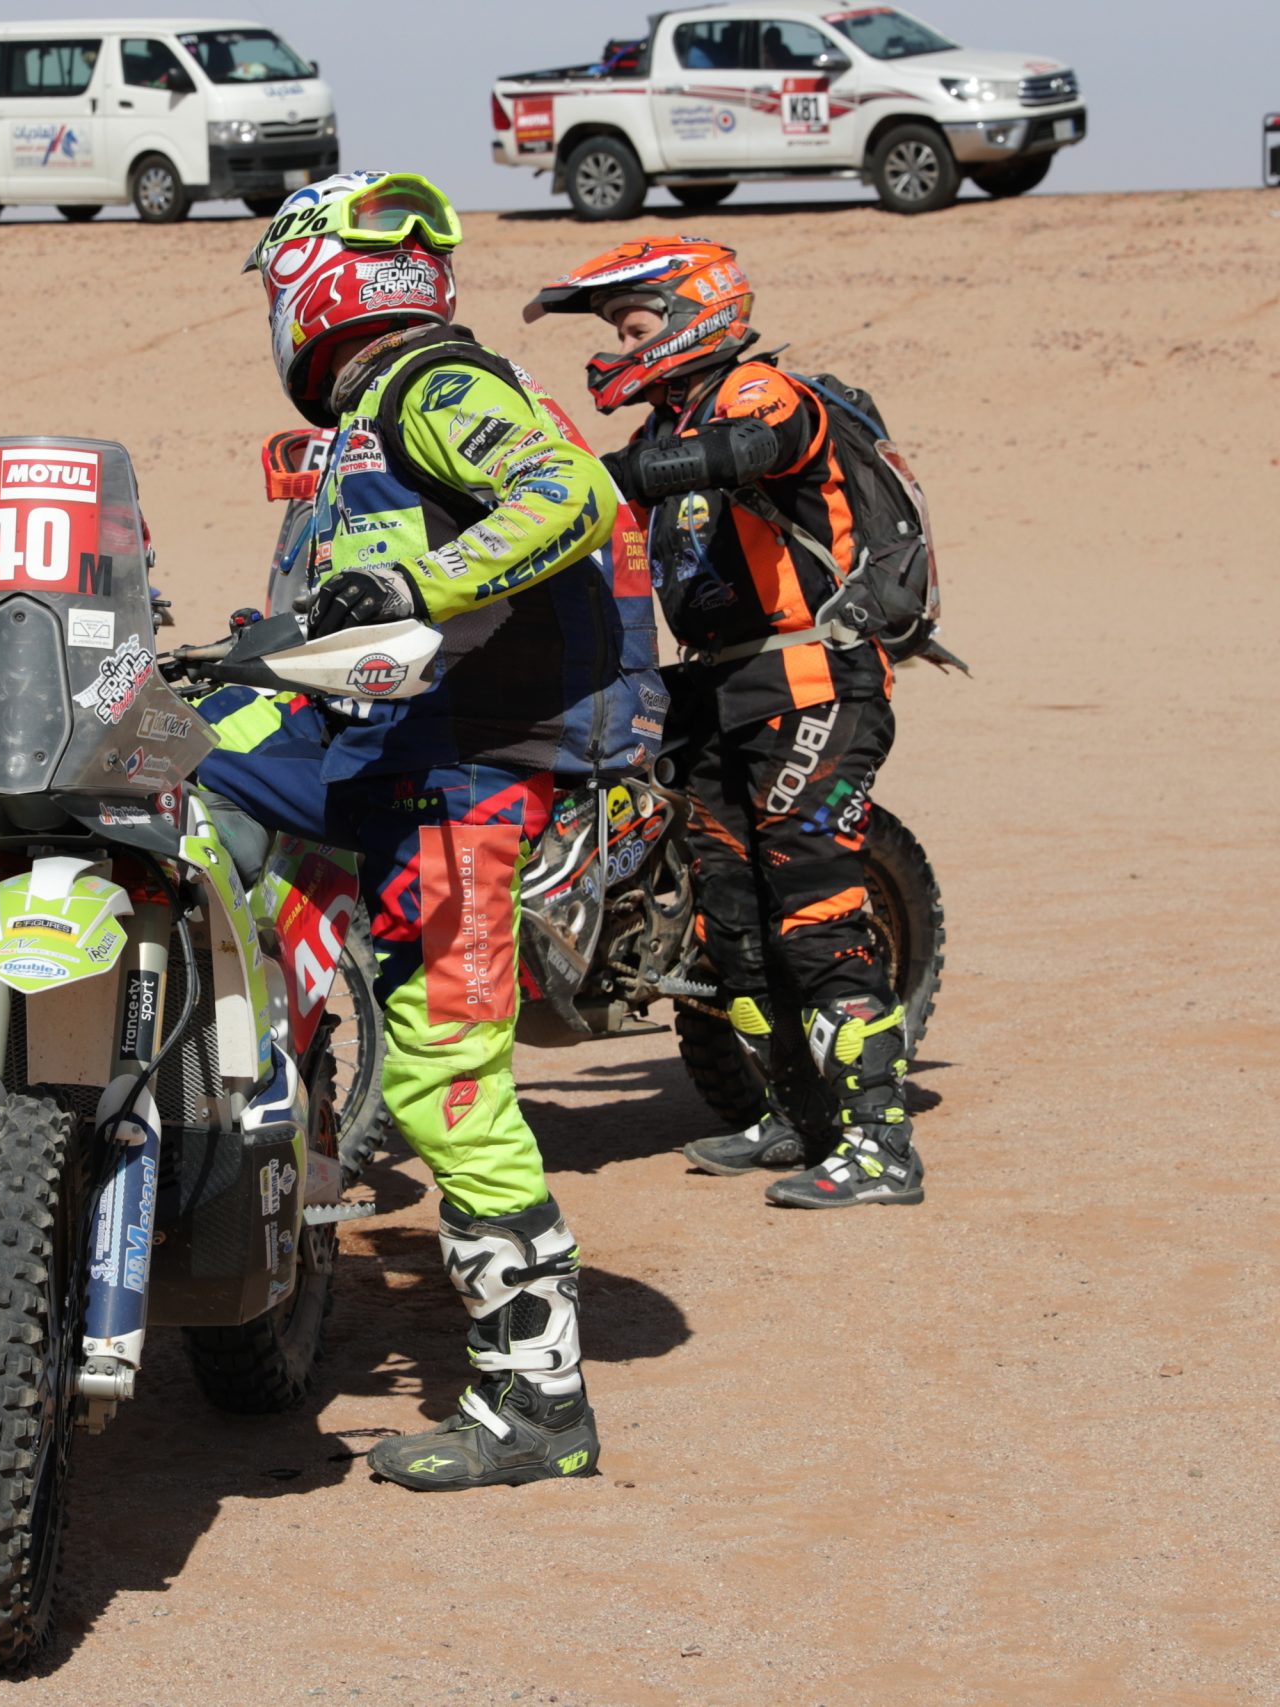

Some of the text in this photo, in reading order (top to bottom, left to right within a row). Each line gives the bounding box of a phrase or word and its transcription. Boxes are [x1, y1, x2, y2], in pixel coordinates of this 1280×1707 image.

[790, 94, 820, 124] K81
[361, 280, 436, 301] STRAVER
[376, 268, 425, 283] EDWIN
[463, 418, 500, 459] pelgrim
[6, 463, 92, 486] MOTUL
[475, 486, 601, 601] KENNY
[78, 552, 113, 597] M
[96, 651, 152, 722] STRAVER
[99, 653, 137, 700] EDWIN
[346, 663, 409, 686] NILS
[766, 699, 841, 814] DOUBL
[837, 789, 867, 833] CSN
[461, 847, 475, 937] Hollander
[295, 894, 356, 1019] 40
[141, 979, 155, 1021] sport
